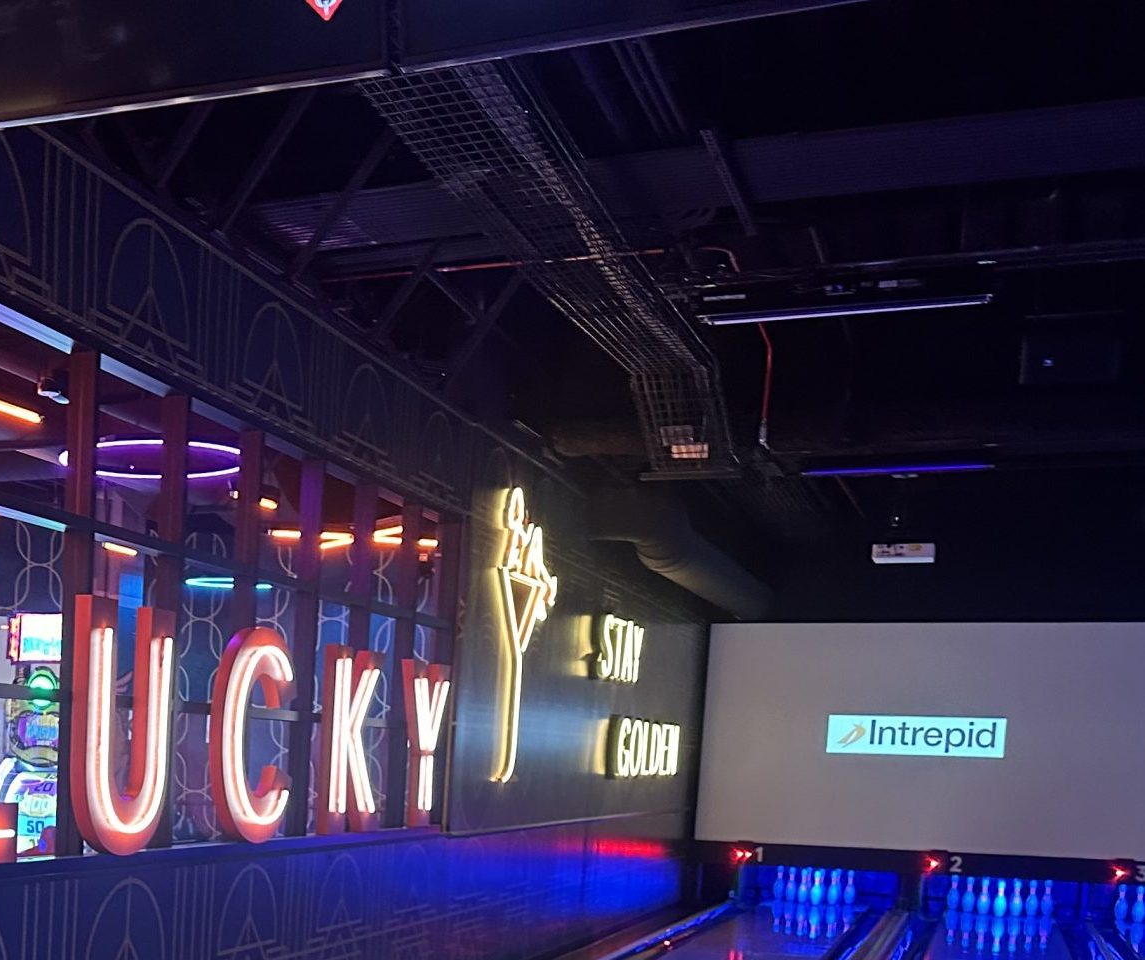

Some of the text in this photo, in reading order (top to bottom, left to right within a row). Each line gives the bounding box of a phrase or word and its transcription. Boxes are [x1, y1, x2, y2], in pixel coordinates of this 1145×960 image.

[597, 614, 645, 684] STAY
[615, 717, 681, 777] GOLDEN
[869, 719, 997, 753] Intrepid
[27, 820, 45, 834] 50
[755, 846, 764, 863] 1
[949, 856, 963, 873] 2
